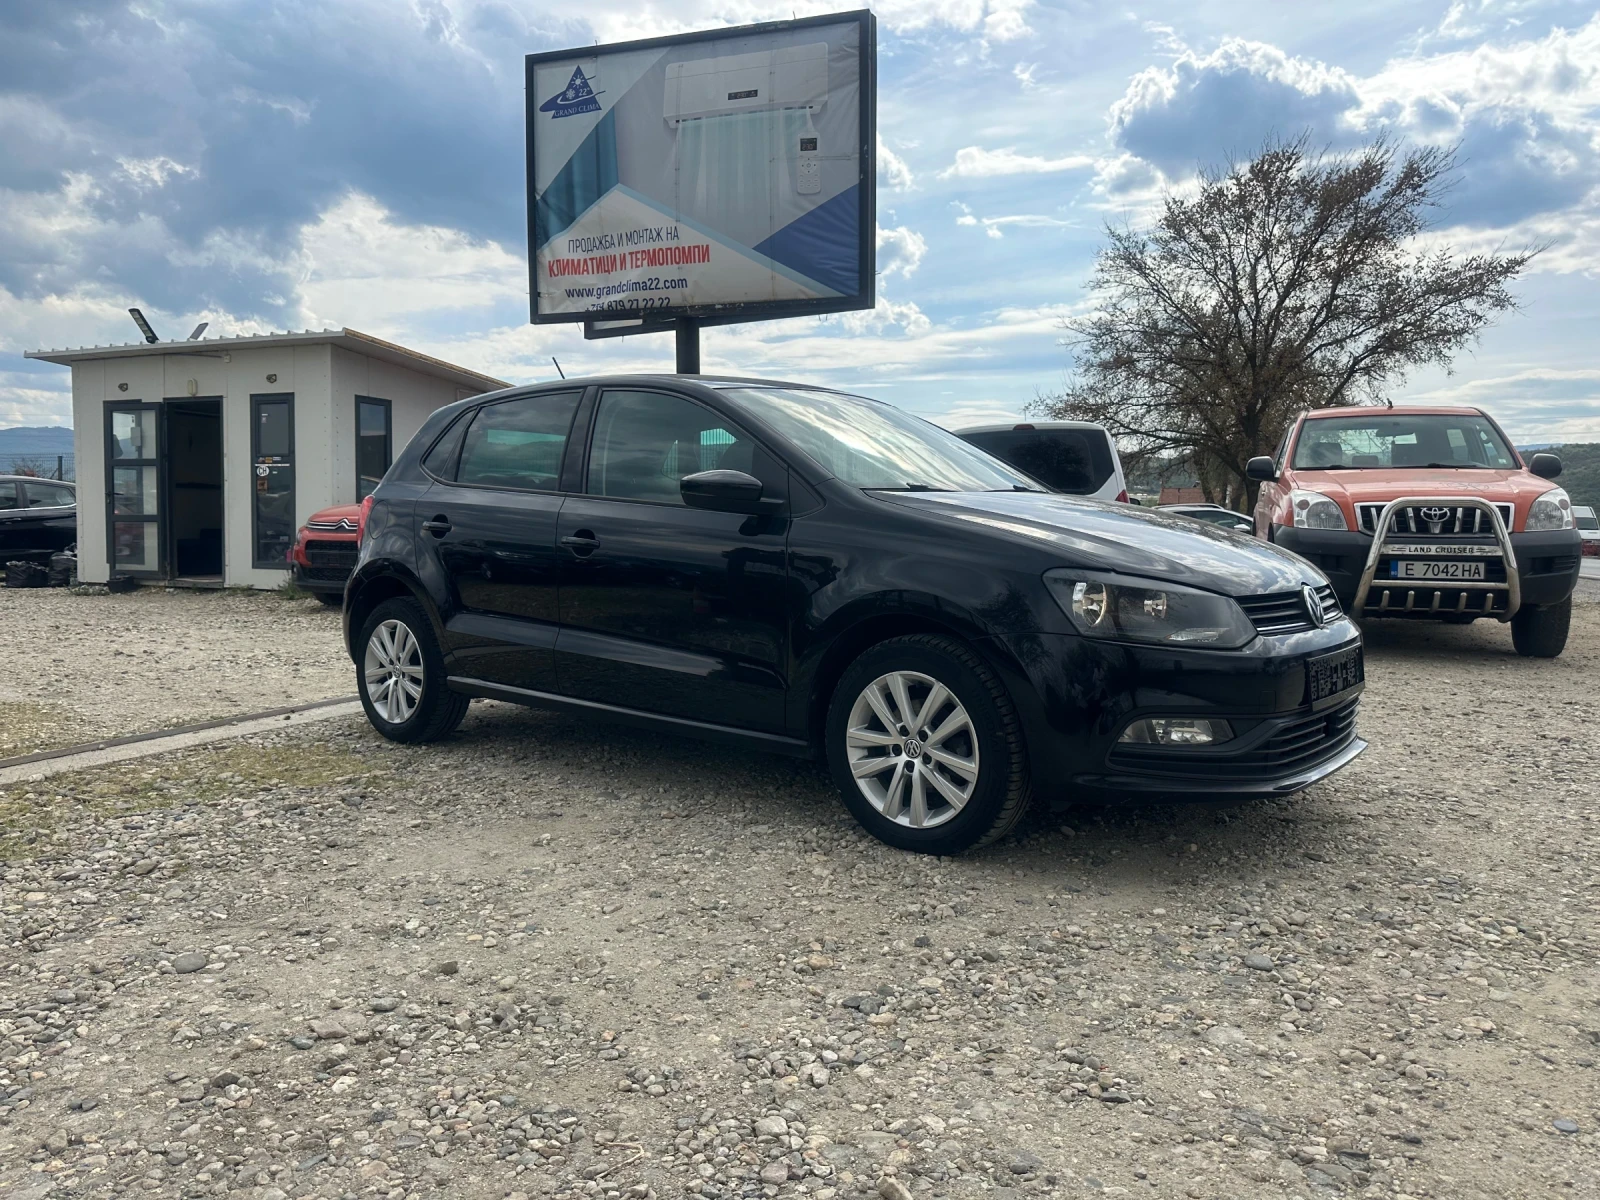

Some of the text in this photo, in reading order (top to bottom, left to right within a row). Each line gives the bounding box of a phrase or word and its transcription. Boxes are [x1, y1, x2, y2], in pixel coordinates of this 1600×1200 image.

[554, 103, 600, 117] GRAND CLIMA
[568, 226, 680, 254] ПРОДАЖБА И МОНТАЖ НА
[548, 244, 711, 278] КЛИМАТИЦИ И ТЕРМОПОМПИ
[565, 277, 688, 299] www.grandclima22.com
[1435, 546, 1474, 554] CRUISER
[1405, 563, 1414, 576] E
